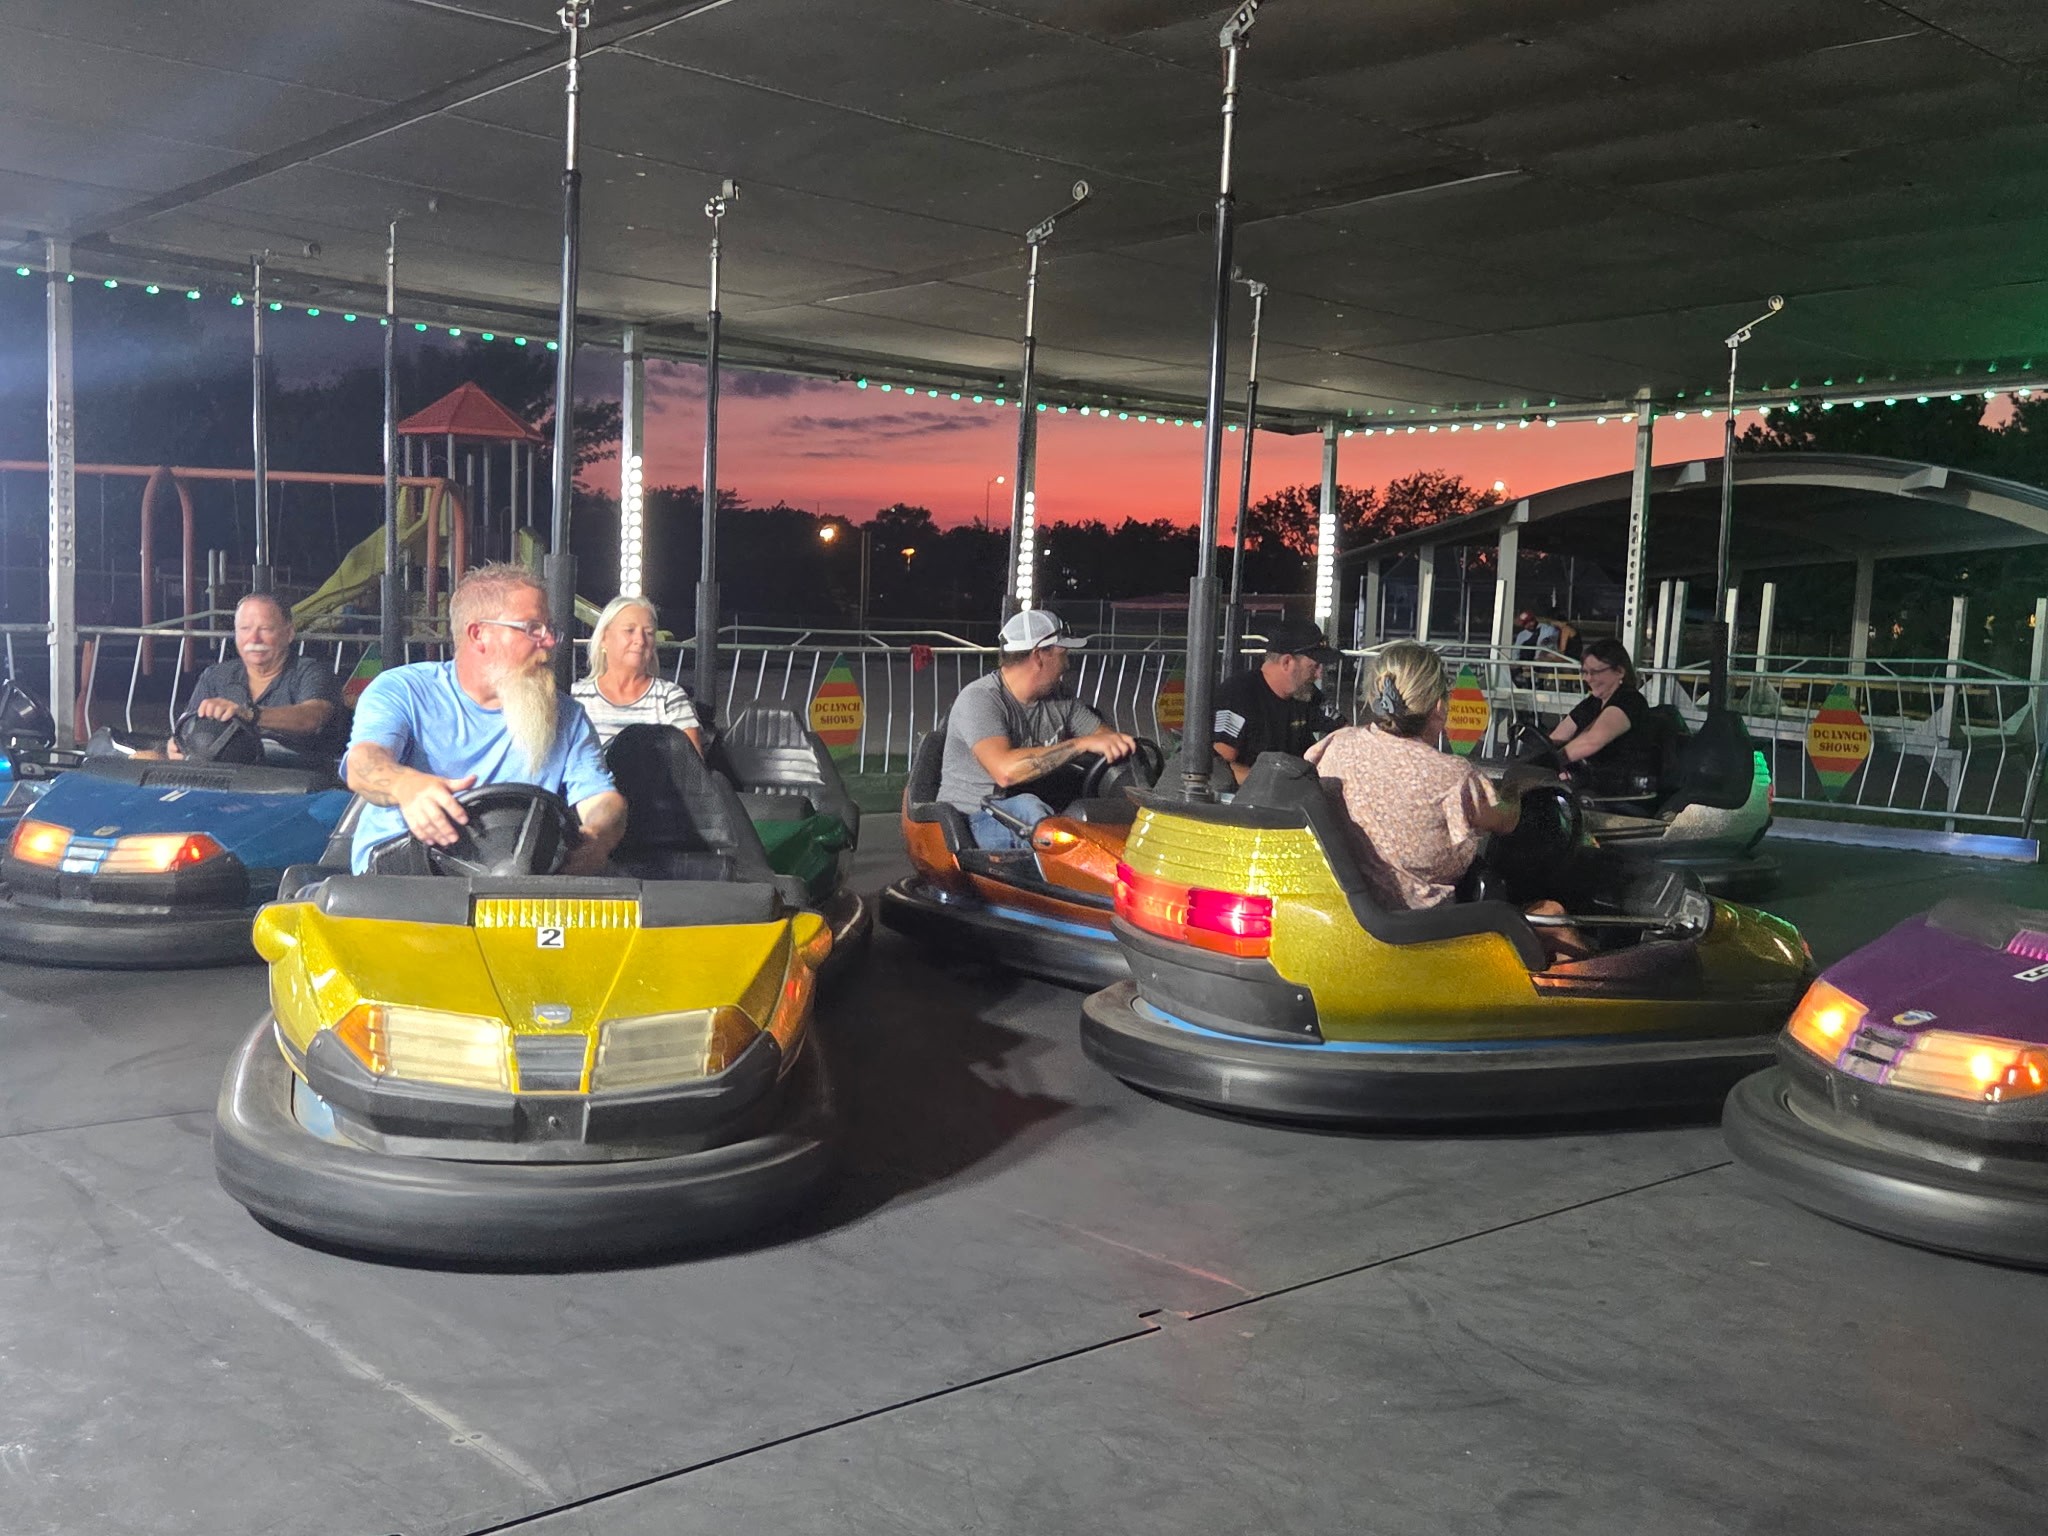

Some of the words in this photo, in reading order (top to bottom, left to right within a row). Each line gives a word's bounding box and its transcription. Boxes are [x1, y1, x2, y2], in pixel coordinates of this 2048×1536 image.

[814, 702, 829, 713] DC
[830, 702, 861, 712] LYNCH
[1460, 705, 1487, 715] LYNCH
[820, 715, 855, 725] SHOWS
[1451, 716, 1481, 725] SHOWS
[1813, 729, 1829, 739] DC
[1830, 729, 1867, 742] LYNCH
[1818, 741, 1859, 753] SHOWS
[541, 929, 561, 946] 2
